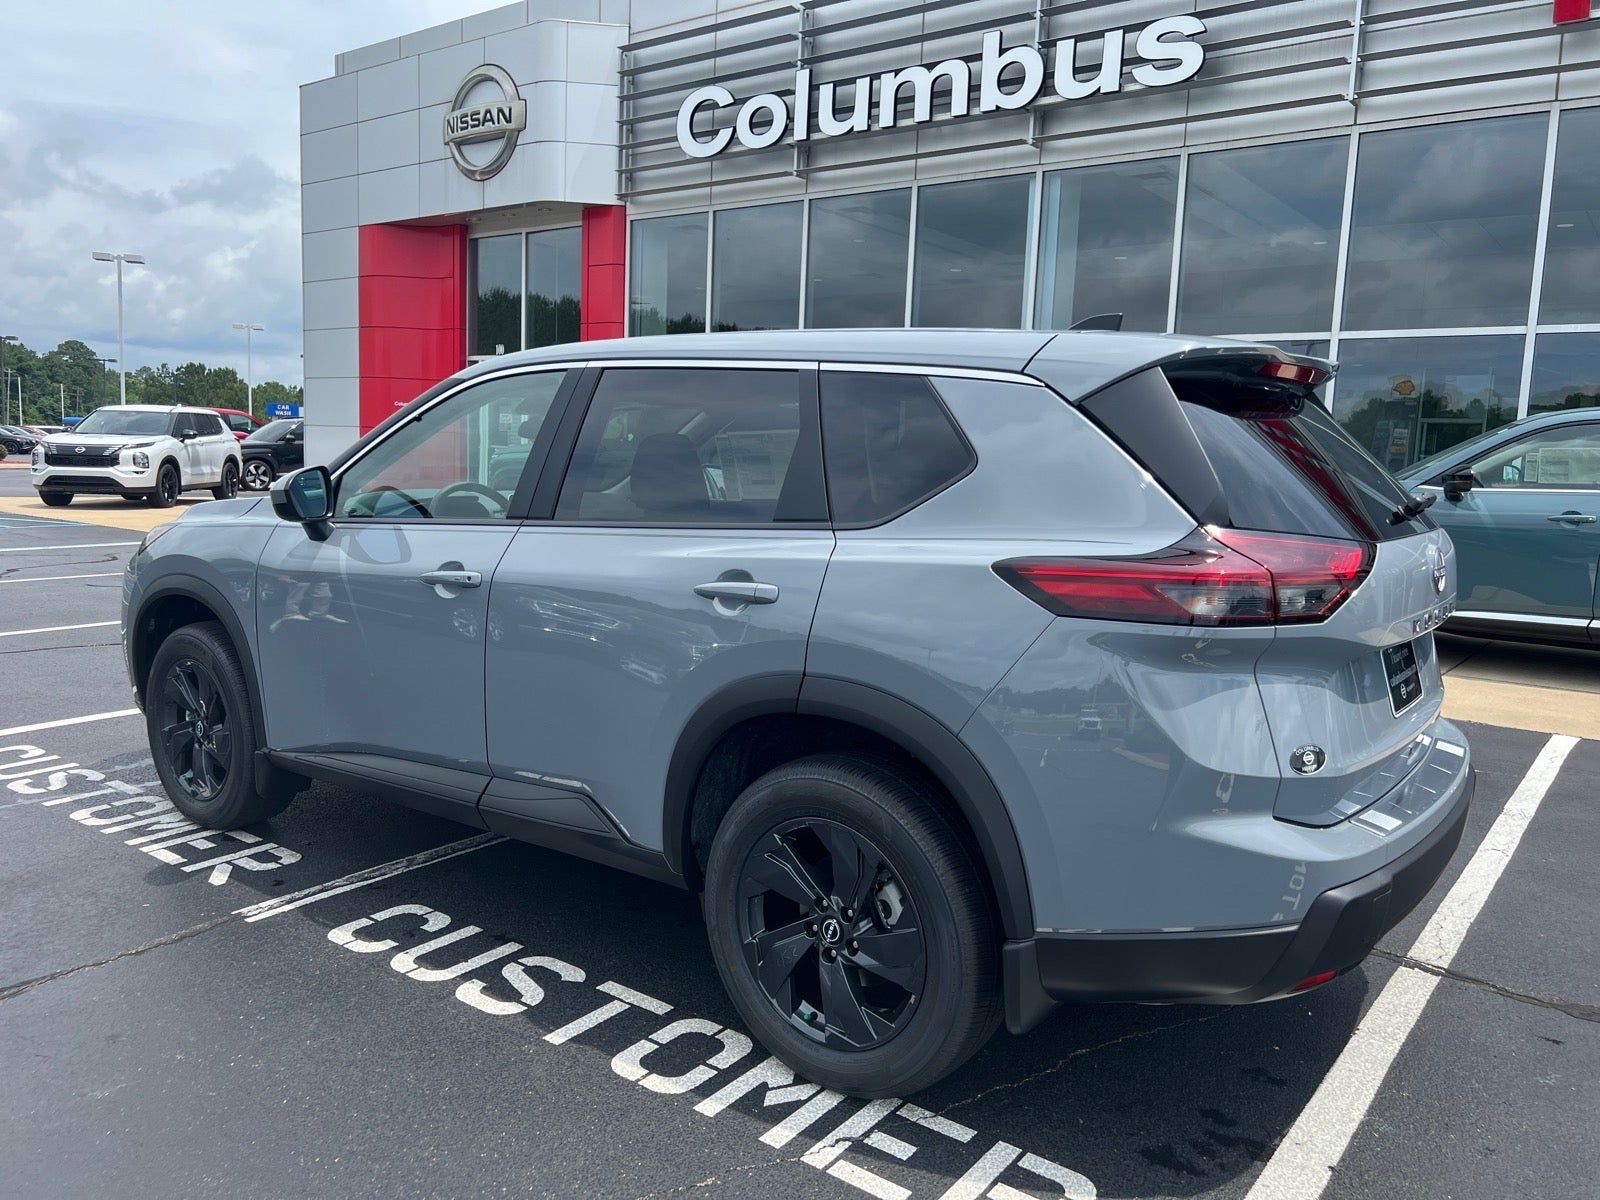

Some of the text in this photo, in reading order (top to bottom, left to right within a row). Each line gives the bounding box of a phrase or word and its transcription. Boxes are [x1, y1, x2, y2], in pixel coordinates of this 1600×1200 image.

[446, 106, 512, 135] NISSAN
[676, 14, 1207, 158] Columbus
[327, 903, 1097, 1200] CUSTOMER
